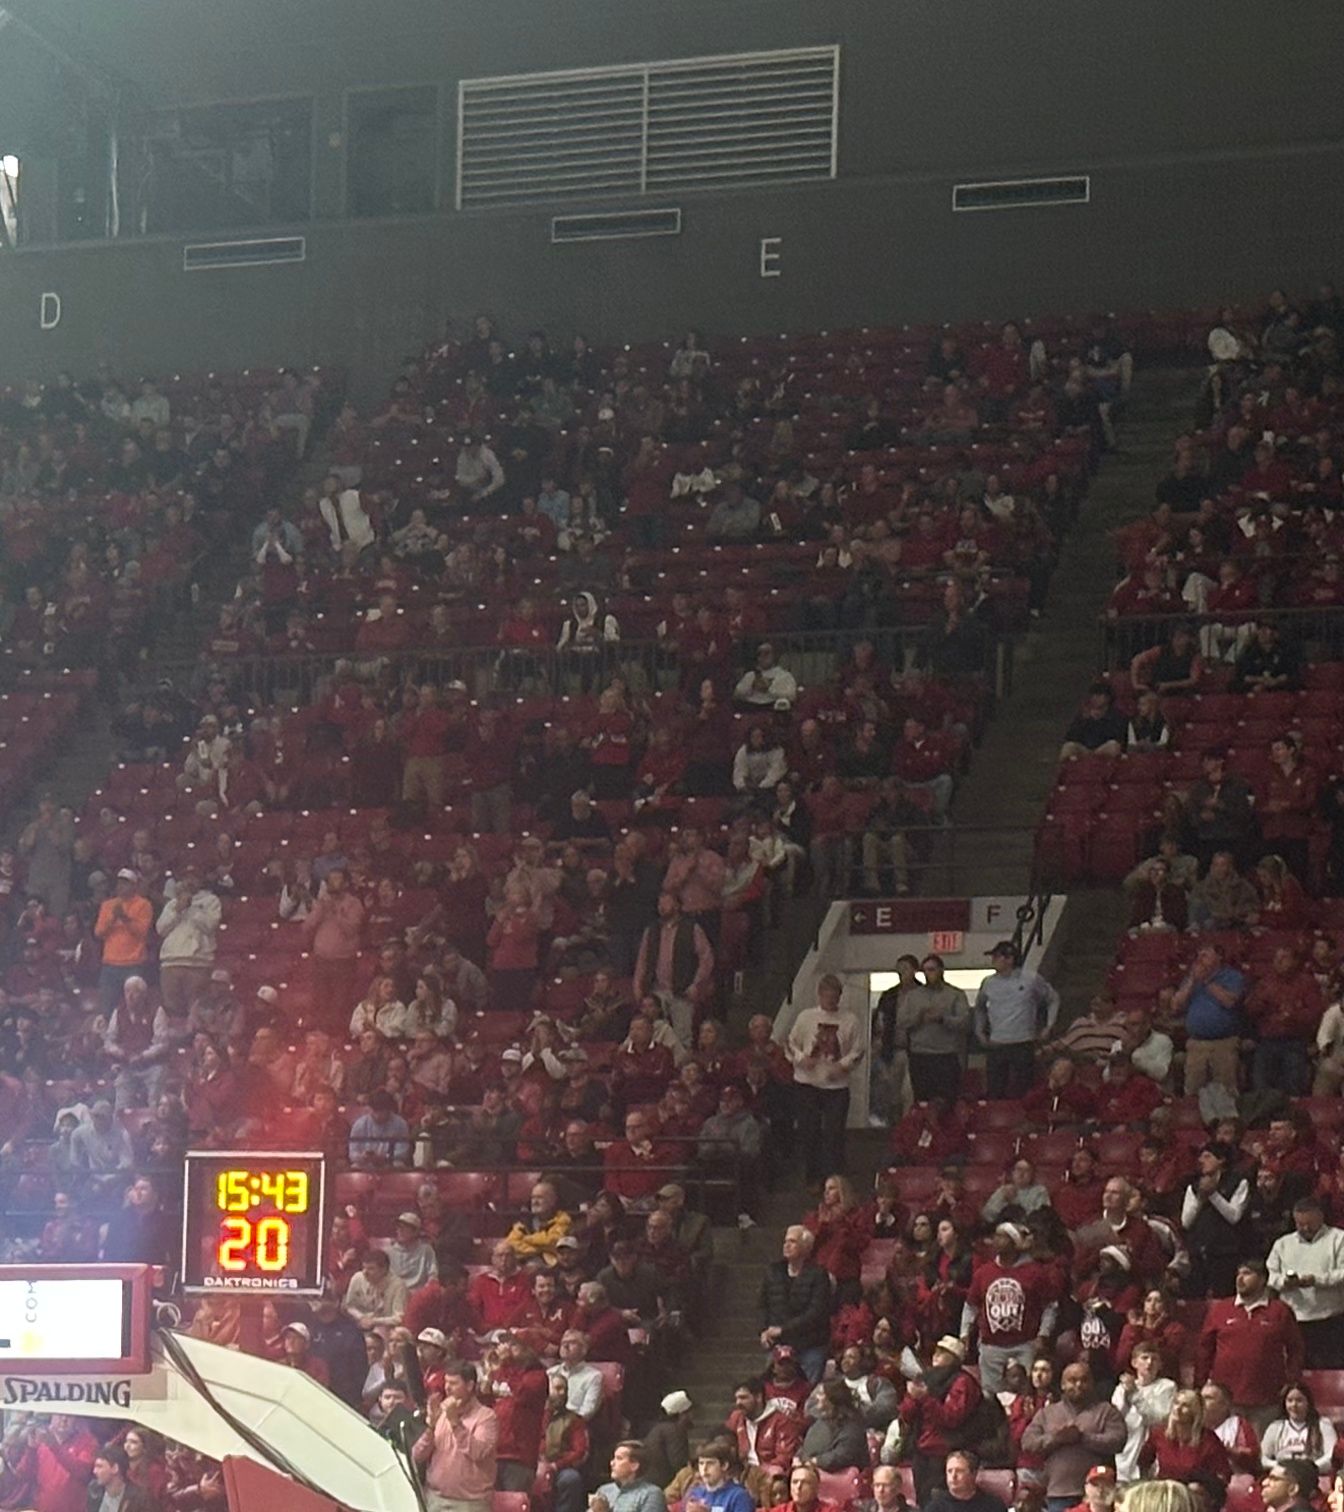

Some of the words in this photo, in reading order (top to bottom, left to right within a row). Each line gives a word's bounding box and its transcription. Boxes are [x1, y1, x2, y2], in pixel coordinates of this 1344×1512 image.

[761, 238, 782, 278] E
[41, 292, 62, 330] D
[875, 907, 892, 927] E
[986, 905, 1002, 924] F
[217, 1171, 308, 1213] 15:43
[218, 1217, 289, 1271] 20
[203, 1276, 299, 1289] DAKTRONICS
[3, 1376, 132, 1409] SPALDING
